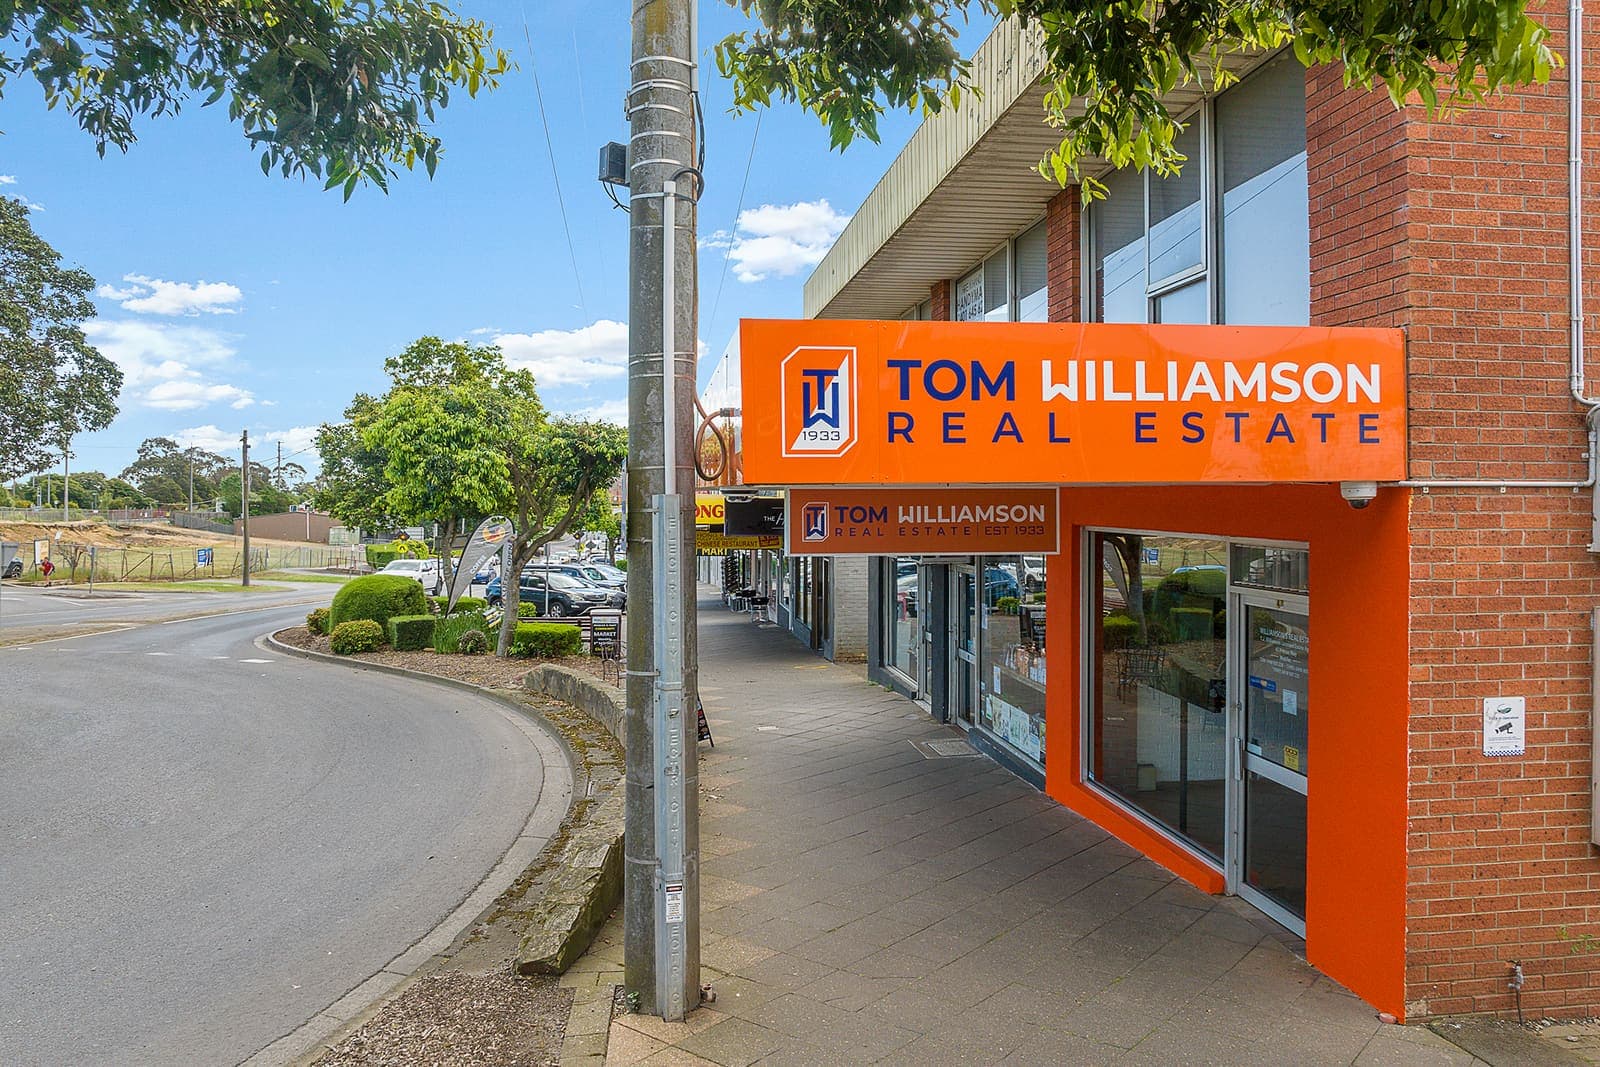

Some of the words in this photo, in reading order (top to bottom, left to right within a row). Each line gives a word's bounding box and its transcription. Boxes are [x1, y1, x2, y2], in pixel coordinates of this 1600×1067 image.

[887, 359, 1015, 401] TOM
[1042, 360, 1381, 403] WILLIAMSON
[803, 431, 840, 441] 1933
[888, 412, 1071, 443] REAL
[1135, 412, 1380, 444] ESTATE
[835, 505, 888, 524] TOM
[898, 504, 1045, 524] WILLIAMSON
[835, 527, 884, 537] REAL
[899, 526, 971, 537] ESTATE
[985, 526, 1009, 536] EST
[1015, 526, 1045, 536] 1933
